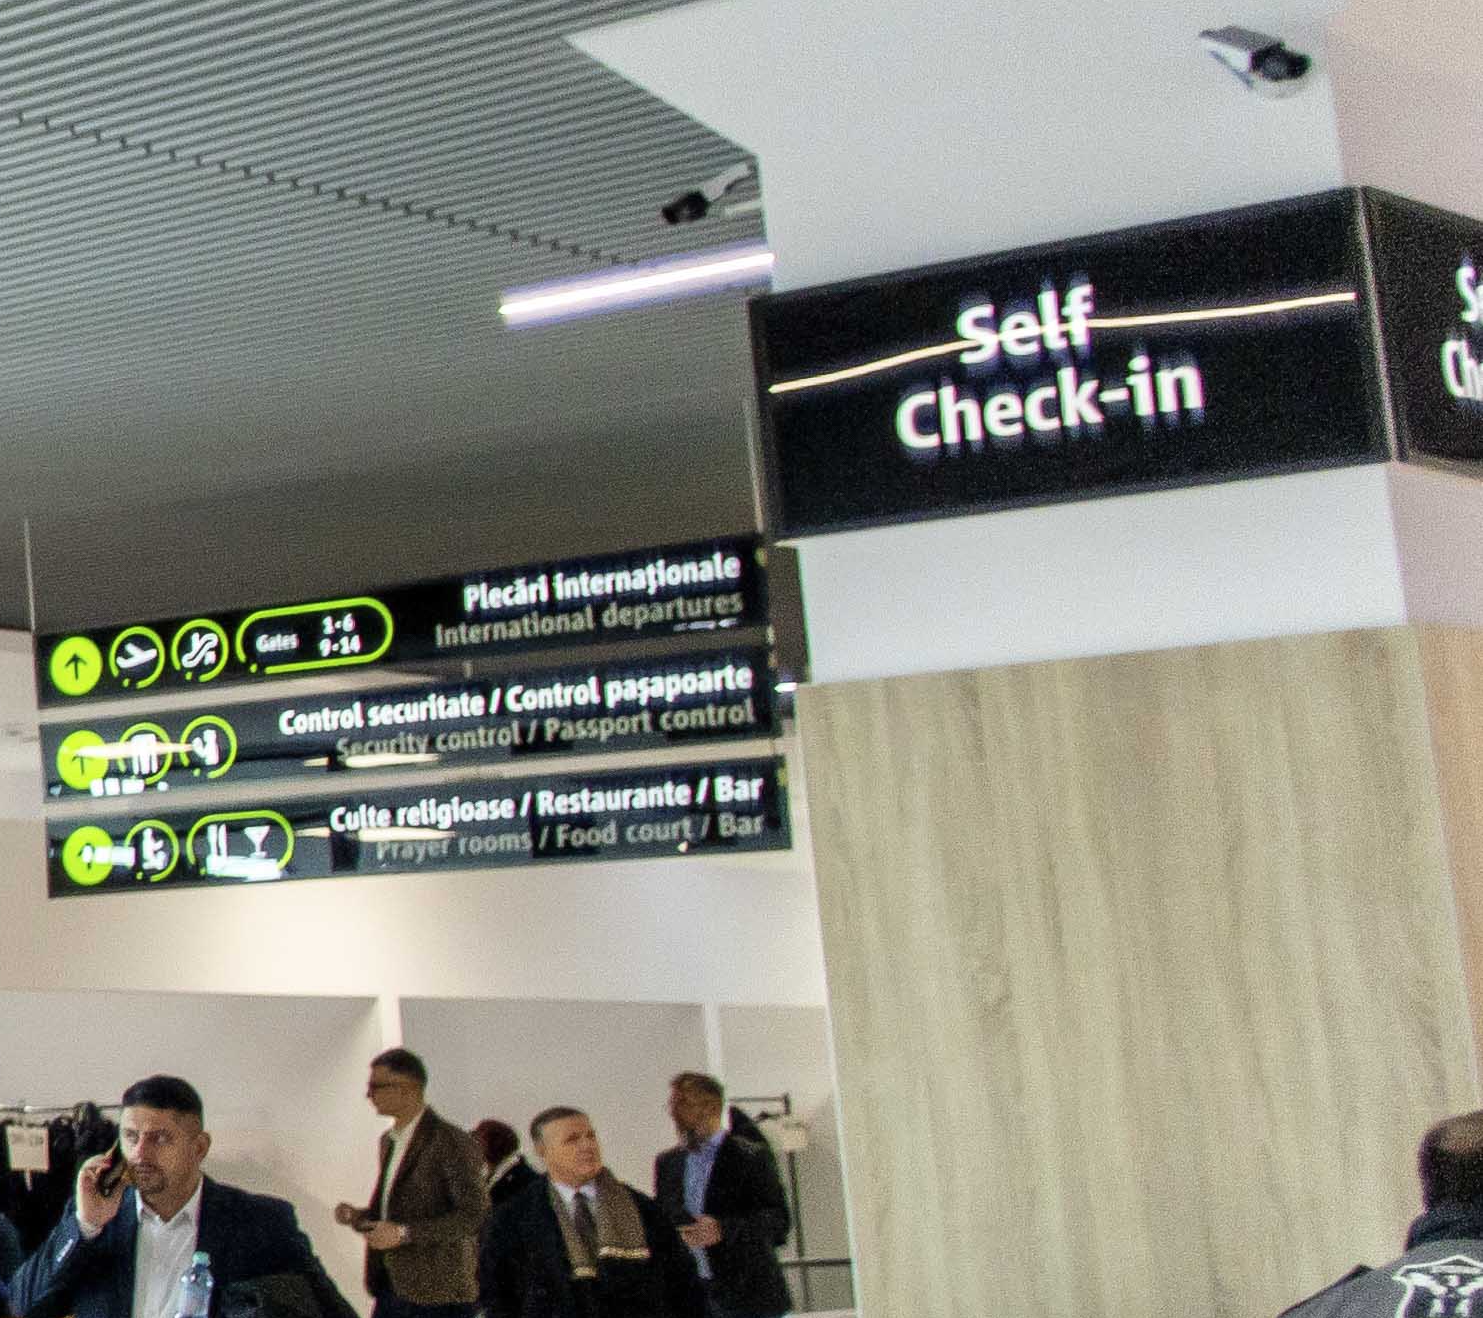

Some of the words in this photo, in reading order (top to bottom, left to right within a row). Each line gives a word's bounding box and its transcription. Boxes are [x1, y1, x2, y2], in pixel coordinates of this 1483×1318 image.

[956, 282, 1095, 365] Self
[1456, 266, 1483, 322] S
[1441, 340, 1483, 400] Ch
[896, 354, 1205, 450] Check-in
[463, 574, 548, 612] Plecări
[553, 551, 741, 601] internaționale
[256, 633, 300, 652] Gates
[435, 604, 594, 648] International
[602, 592, 743, 629] departures
[278, 702, 364, 736] Control
[368, 692, 484, 728] securitate
[489, 687, 501, 715] /
[506, 678, 599, 713] Control
[605, 663, 753, 708] pașapoarte
[336, 725, 428, 761] Security
[435, 716, 521, 749] control
[527, 718, 537, 744] /
[544, 709, 651, 743] Passport
[659, 698, 755, 731] control
[330, 803, 390, 833] Culte
[396, 794, 515, 830] religioase
[520, 792, 532, 818] /
[537, 778, 691, 816] Restaurante
[696, 777, 709, 804] /
[714, 775, 764, 802] Bar
[458, 833, 532, 854] rooms
[556, 821, 618, 849] Food
[625, 817, 693, 843] court
[718, 813, 763, 837] Bar
